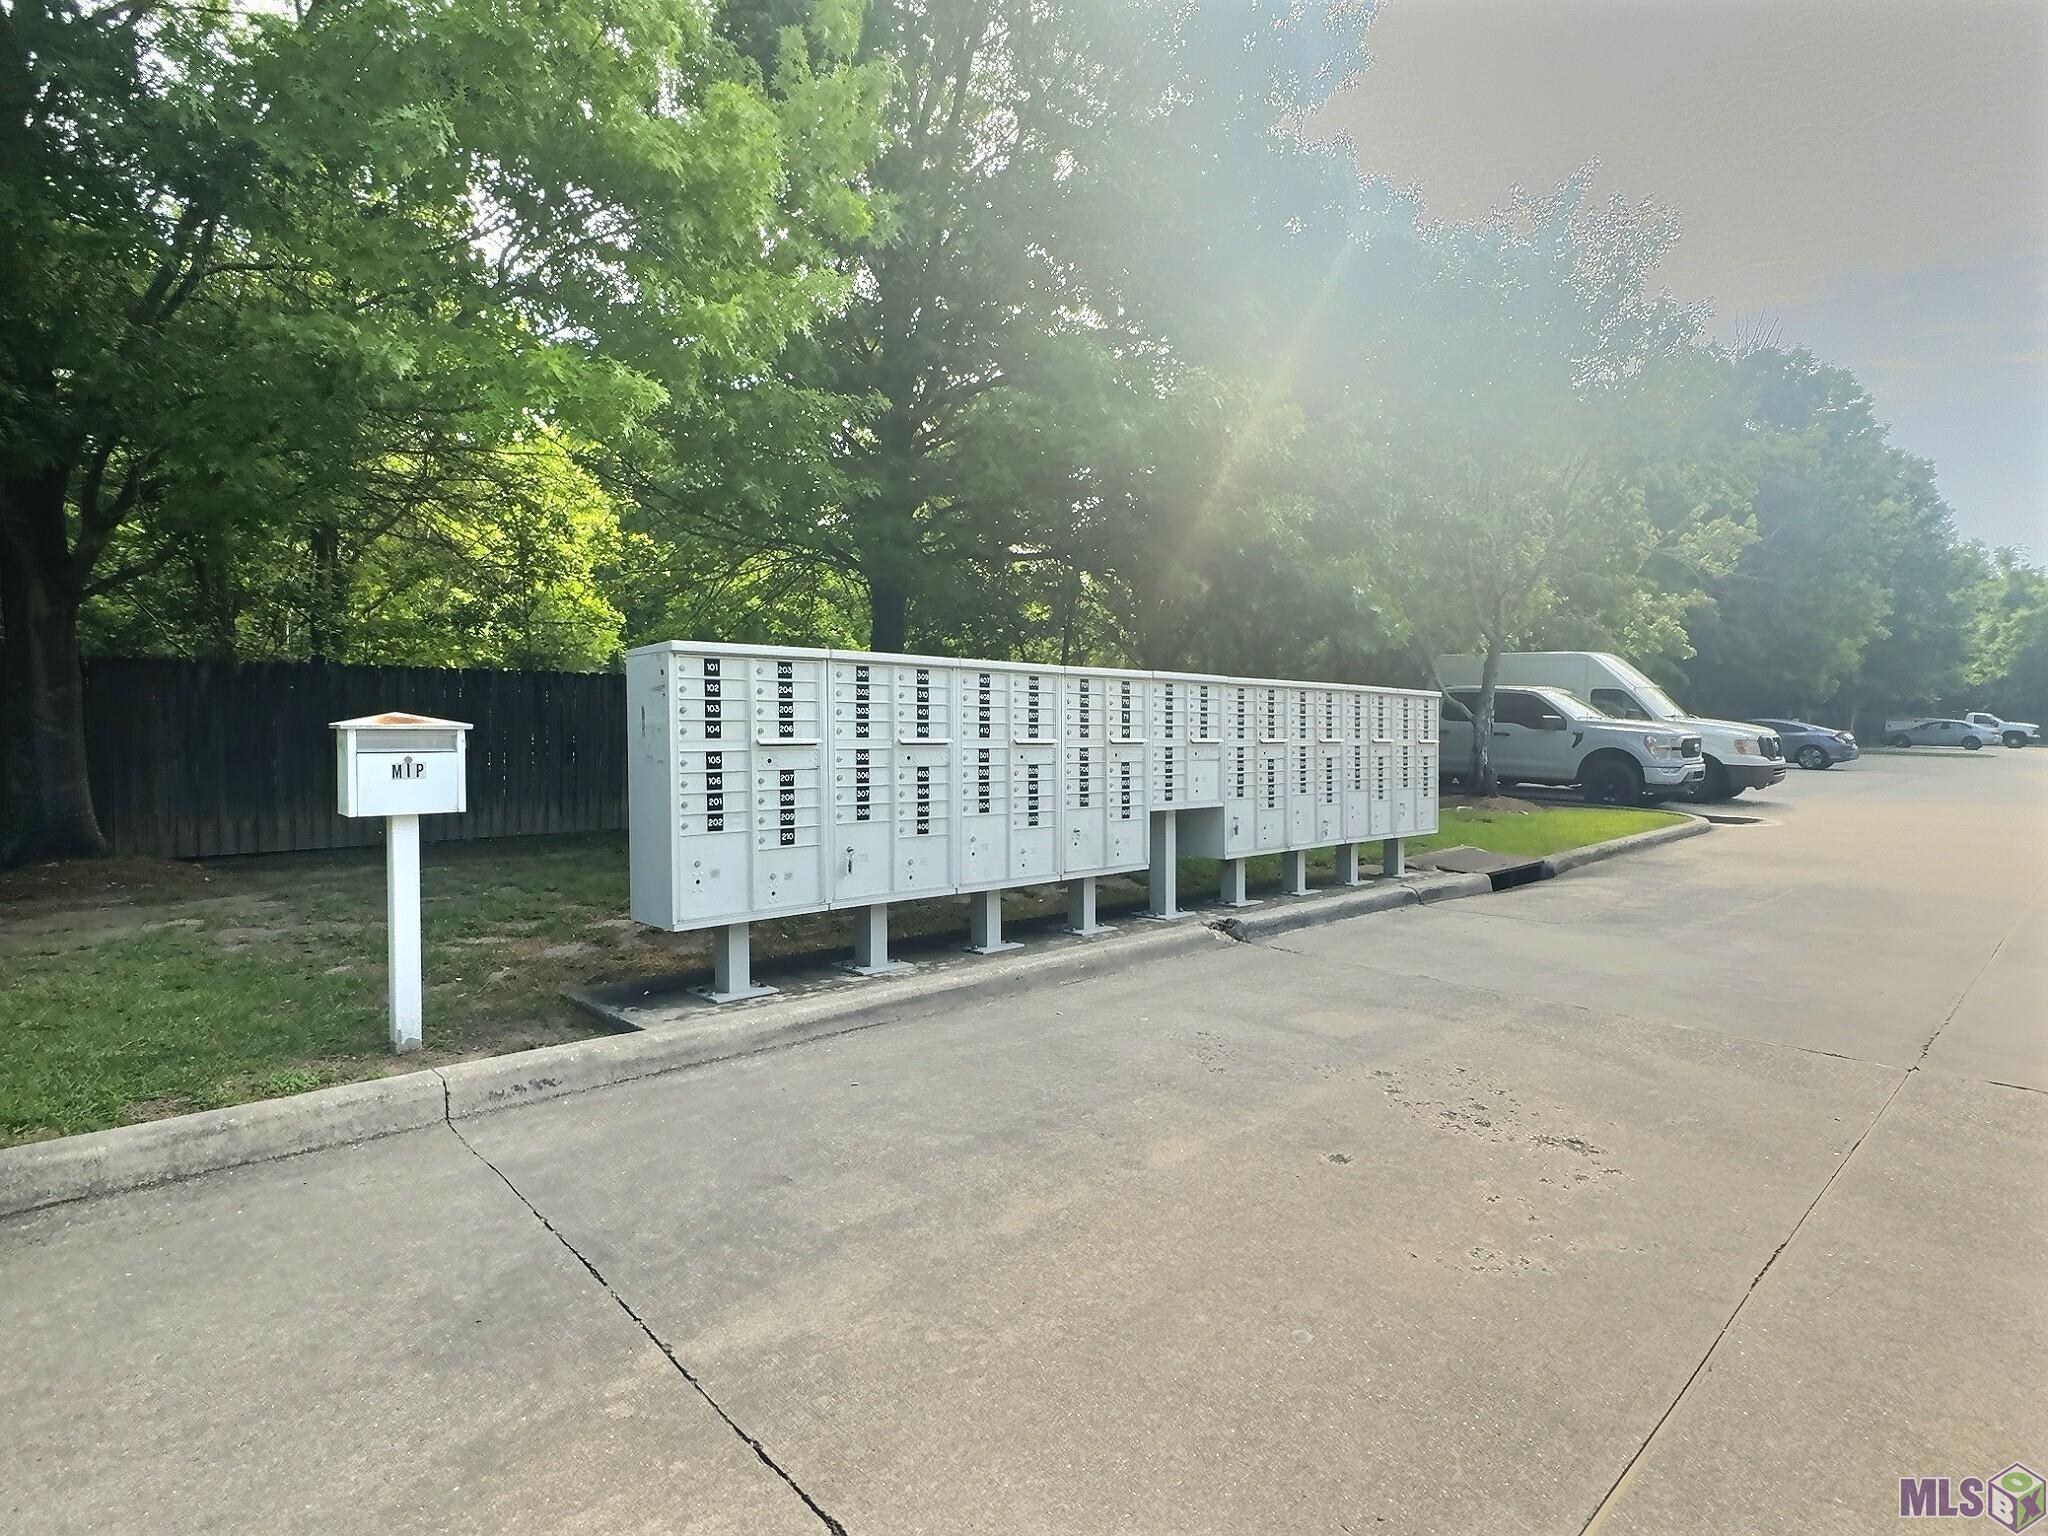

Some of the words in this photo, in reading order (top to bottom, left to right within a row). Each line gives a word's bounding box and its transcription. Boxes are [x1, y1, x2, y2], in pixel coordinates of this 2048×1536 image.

[706, 663, 718, 671] 101
[778, 666, 792, 674] 203
[707, 683, 719, 692] 102
[707, 704, 720, 713] 103
[779, 706, 793, 714] 205
[707, 725, 720, 733] 104
[780, 725, 793, 733] 206
[708, 756, 721, 764] 105
[391, 763, 424, 779] MIP
[918, 770, 929, 778] 403
[708, 777, 721, 785] 106
[780, 774, 795, 782] 207
[781, 794, 794, 802] 208
[857, 790, 870, 798] 307
[709, 797, 722, 806] 201
[781, 813, 794, 821] 209
[708, 818, 723, 827] 202
[782, 832, 794, 840] 210
